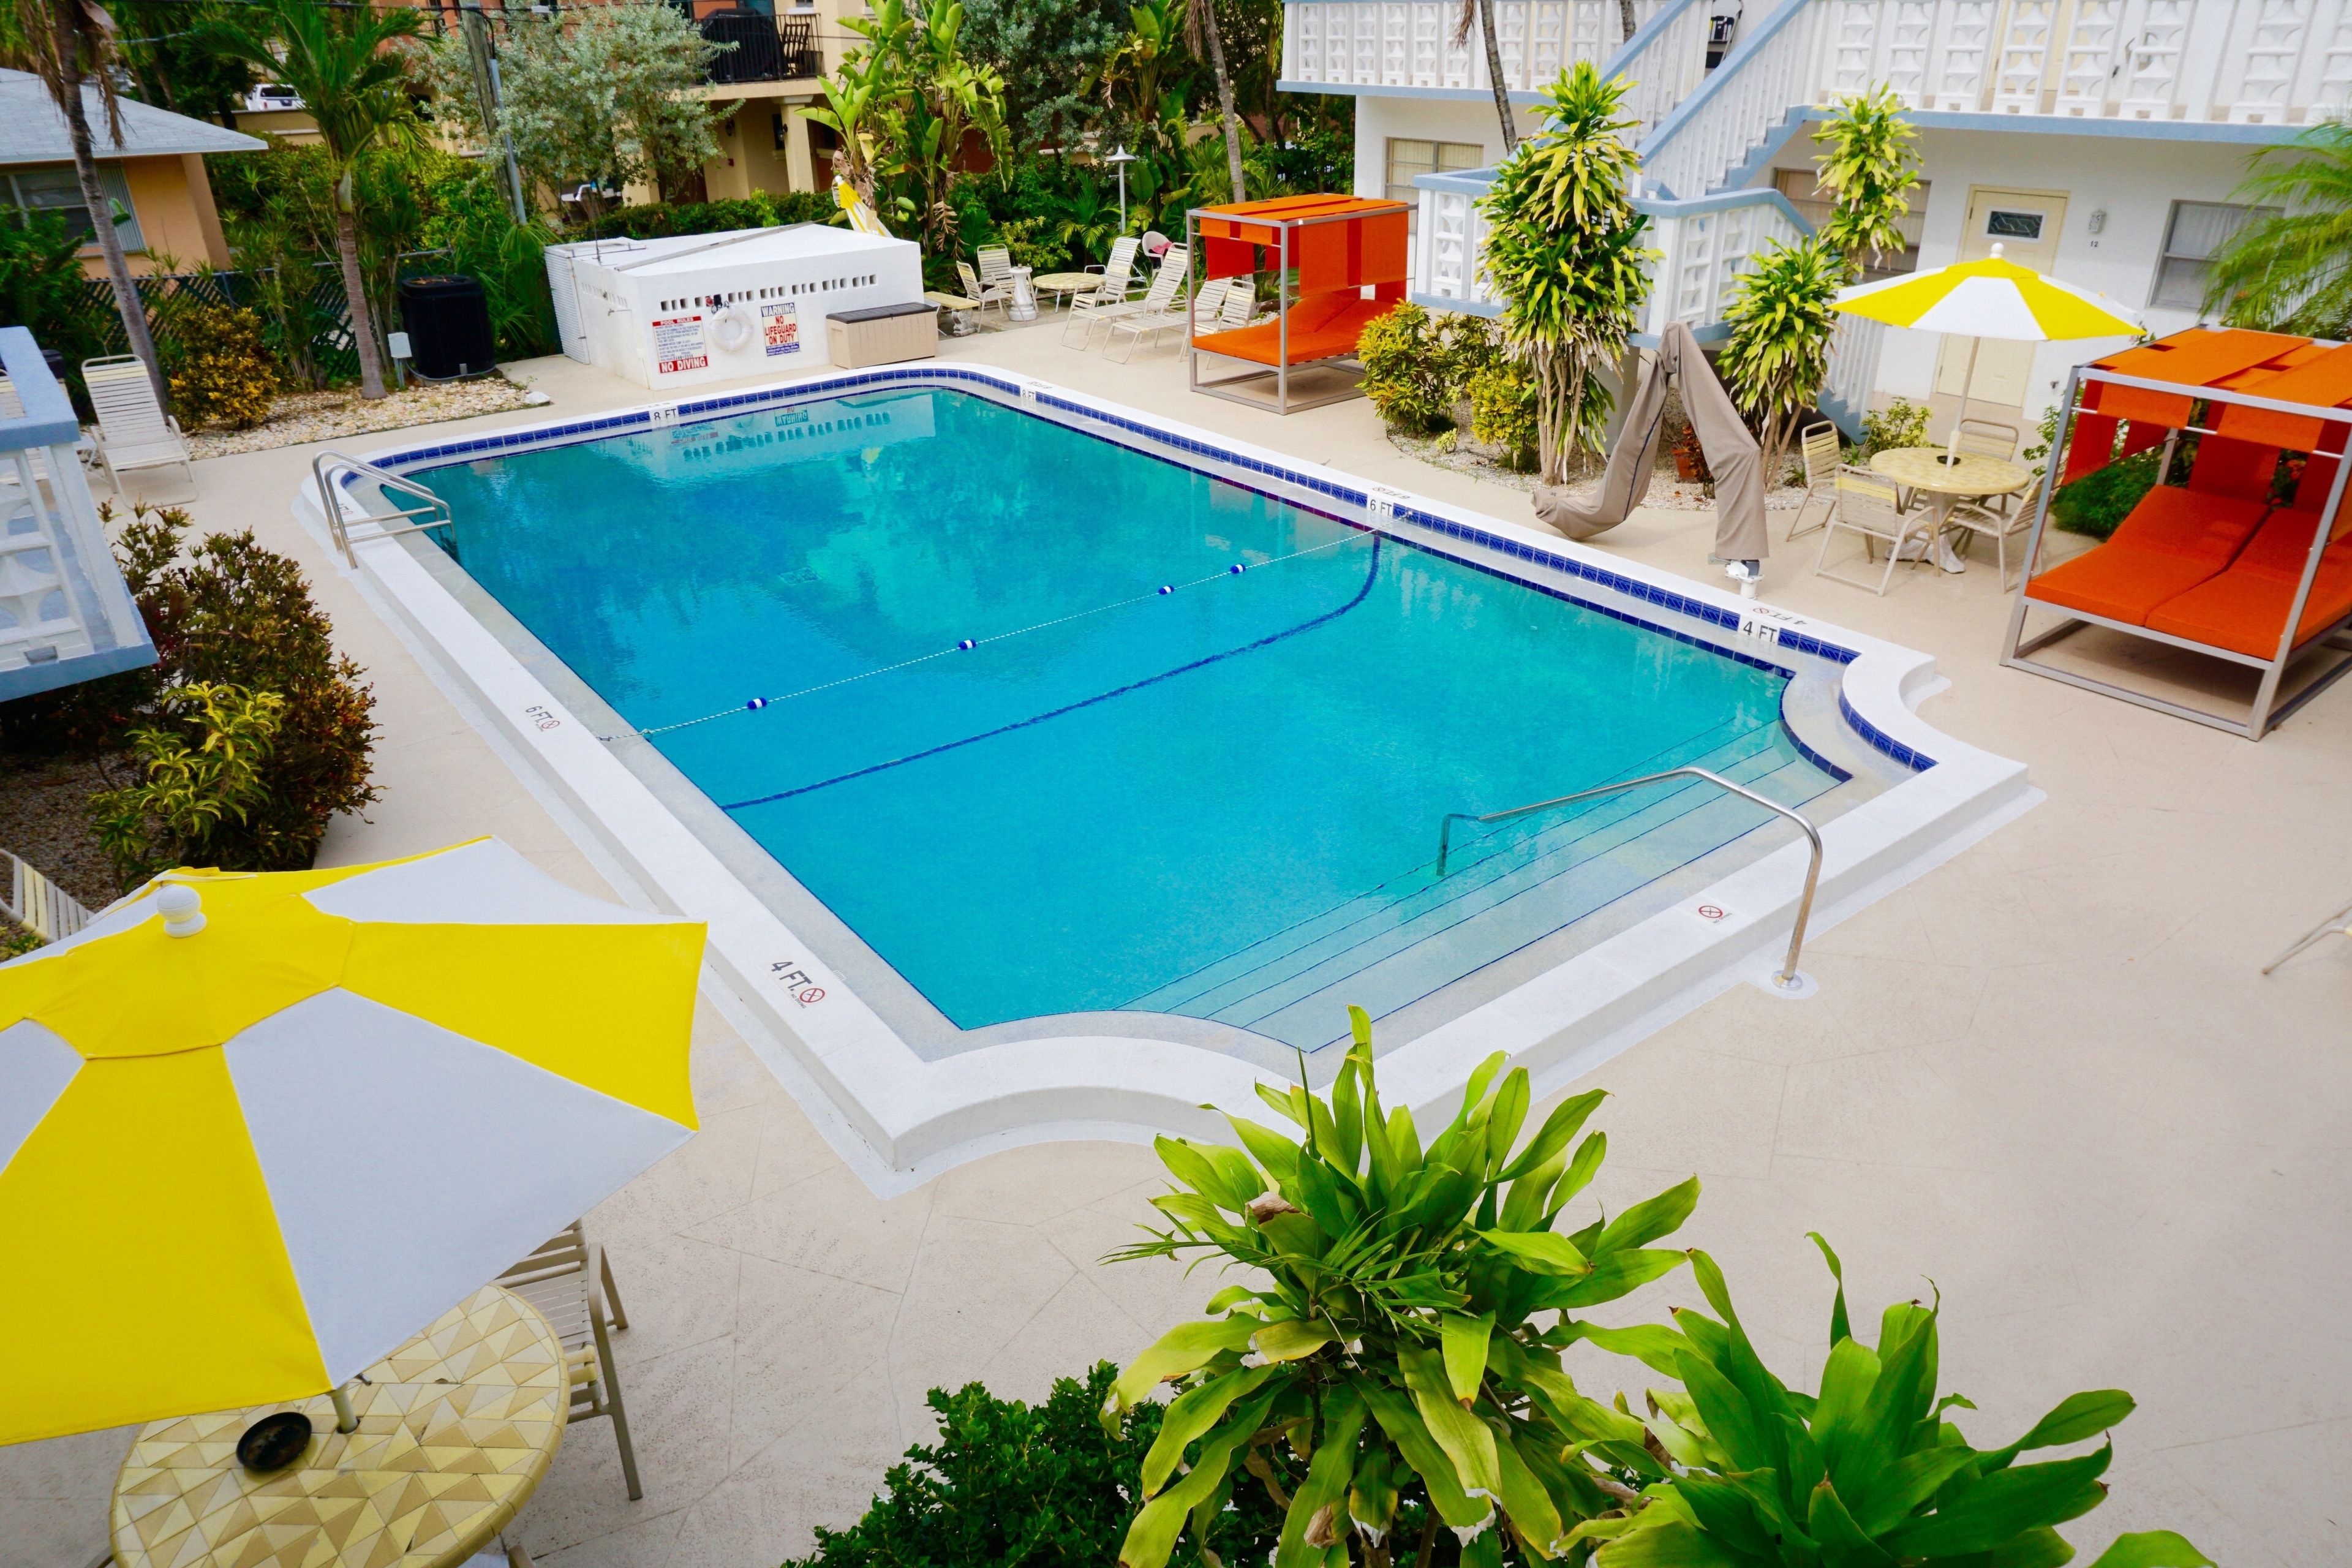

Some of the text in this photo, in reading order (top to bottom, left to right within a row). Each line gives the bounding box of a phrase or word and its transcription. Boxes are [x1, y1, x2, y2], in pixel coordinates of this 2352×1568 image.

[761, 304, 794, 316] WARNING
[775, 315, 784, 325] NO
[764, 323, 796, 336] LIFEGUARD
[769, 333, 794, 345] ON DUTY
[661, 356, 706, 373] NO DIVING
[654, 412, 661, 421] 8
[1370, 499, 1392, 517] 6 FT.
[1743, 621, 1777, 643] 4 FT.
[530, 711, 554, 723] FT.
[771, 961, 813, 992] 4 FT.
